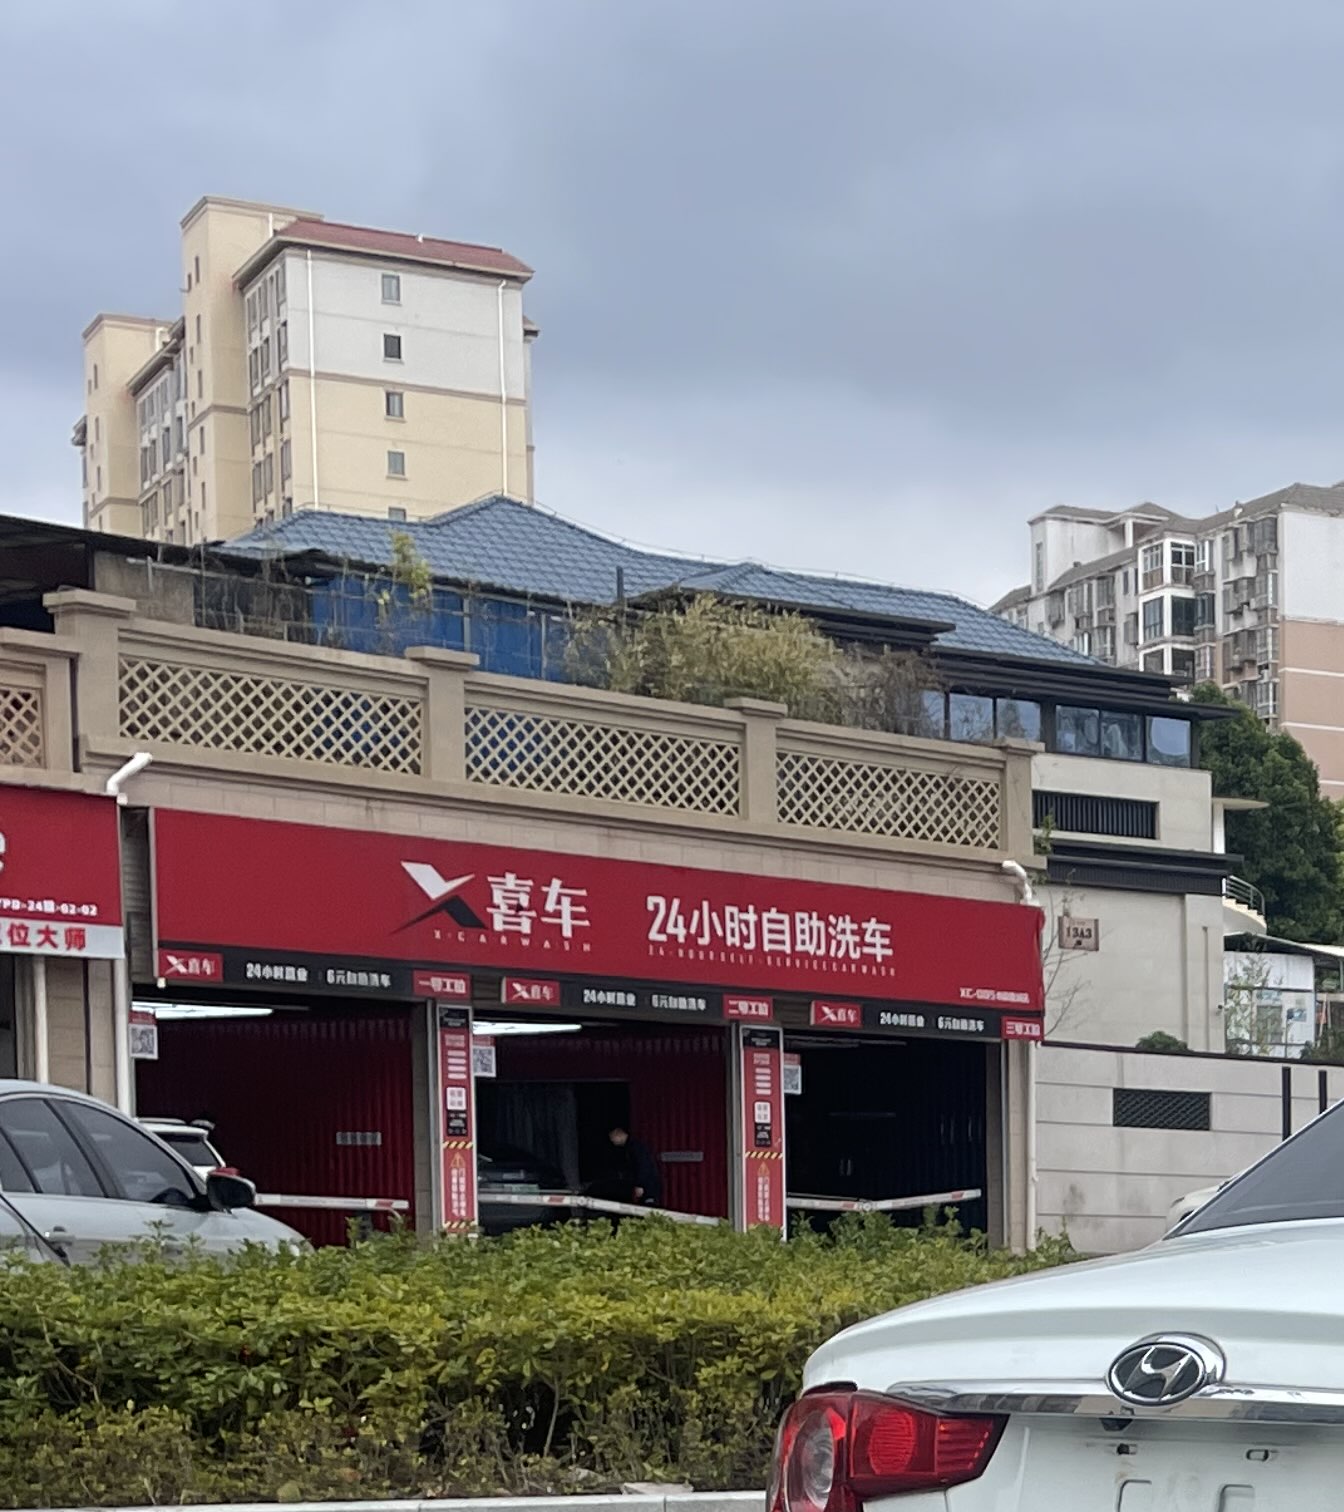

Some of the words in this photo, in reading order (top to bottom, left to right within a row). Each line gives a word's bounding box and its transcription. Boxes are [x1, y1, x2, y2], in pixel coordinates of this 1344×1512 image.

[0, 921, 87, 951] 位大师
[486, 871, 591, 939] 喜车
[646, 895, 894, 963] 24小时自助洗车
